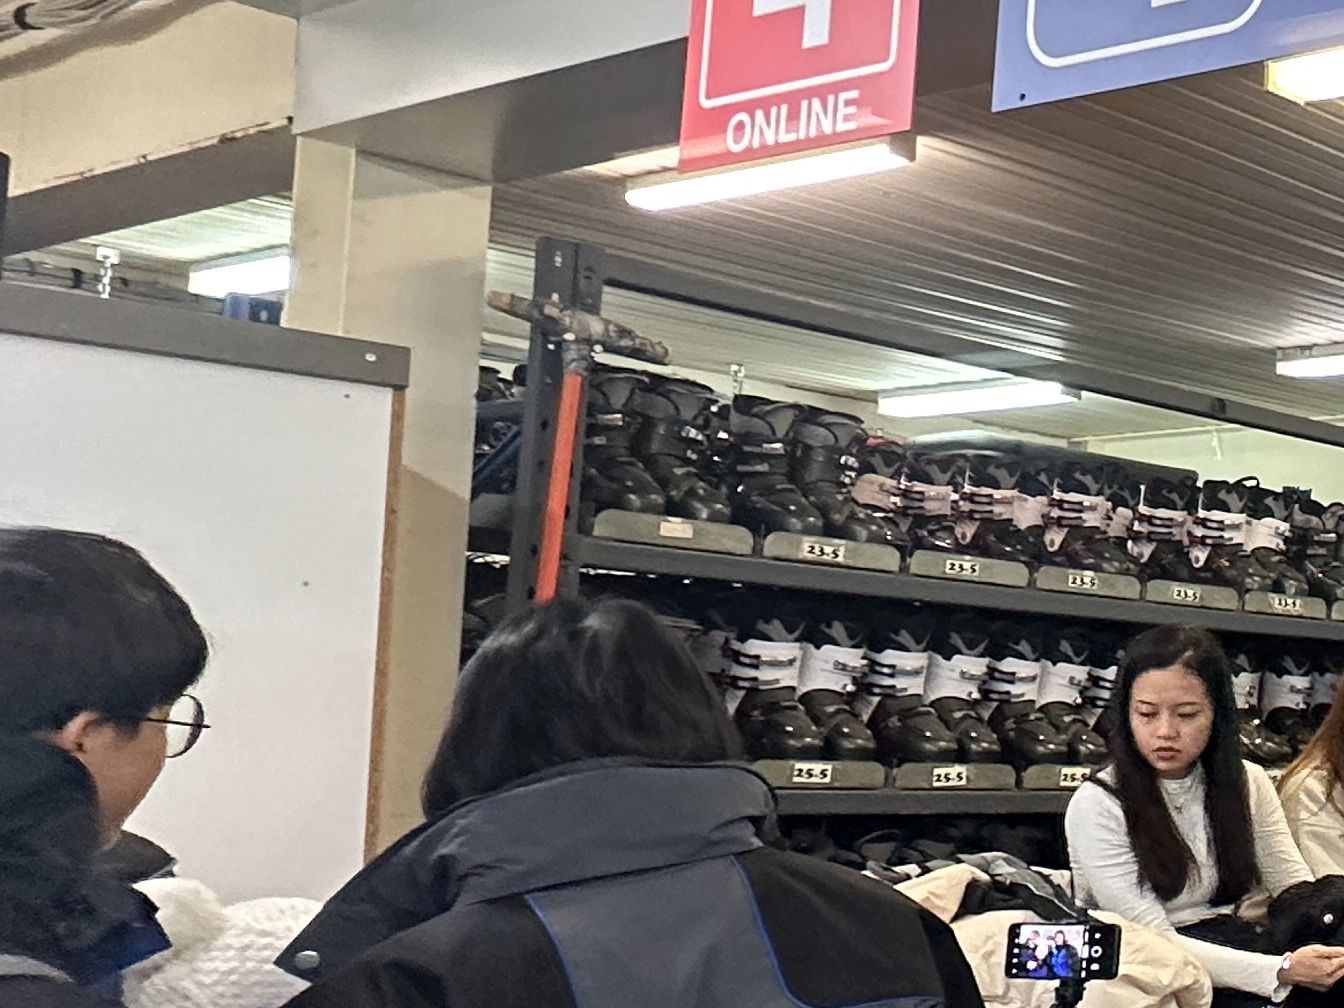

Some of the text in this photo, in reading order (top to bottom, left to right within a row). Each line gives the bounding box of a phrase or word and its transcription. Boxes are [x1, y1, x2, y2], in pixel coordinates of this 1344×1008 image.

[726, 90, 860, 153] ONLINE
[793, 768, 829, 780] 25.5
[934, 771, 964, 783] 25.5
